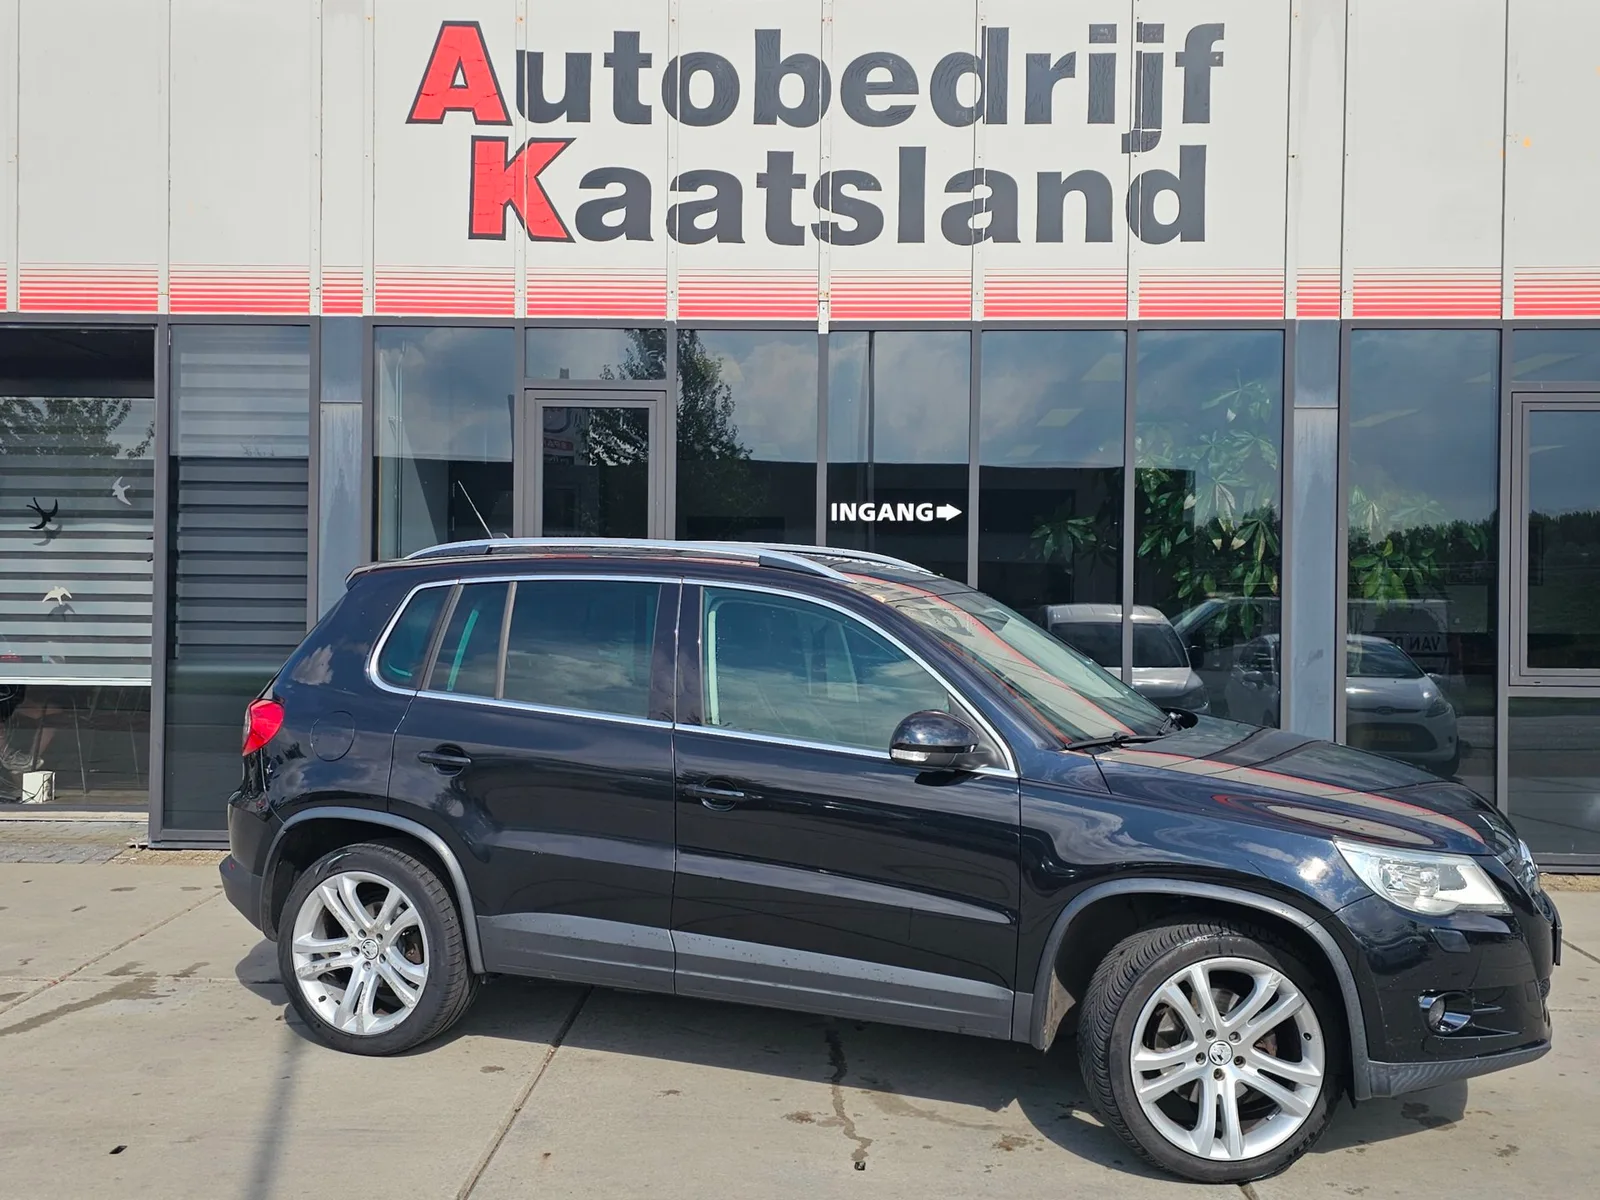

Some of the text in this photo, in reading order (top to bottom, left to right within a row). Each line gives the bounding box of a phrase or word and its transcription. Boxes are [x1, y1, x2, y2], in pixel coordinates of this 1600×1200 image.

[405, 20, 1225, 154] Autobedrijf
[467, 134, 1207, 247] Kaatsland
[830, 502, 934, 522] INGANG
